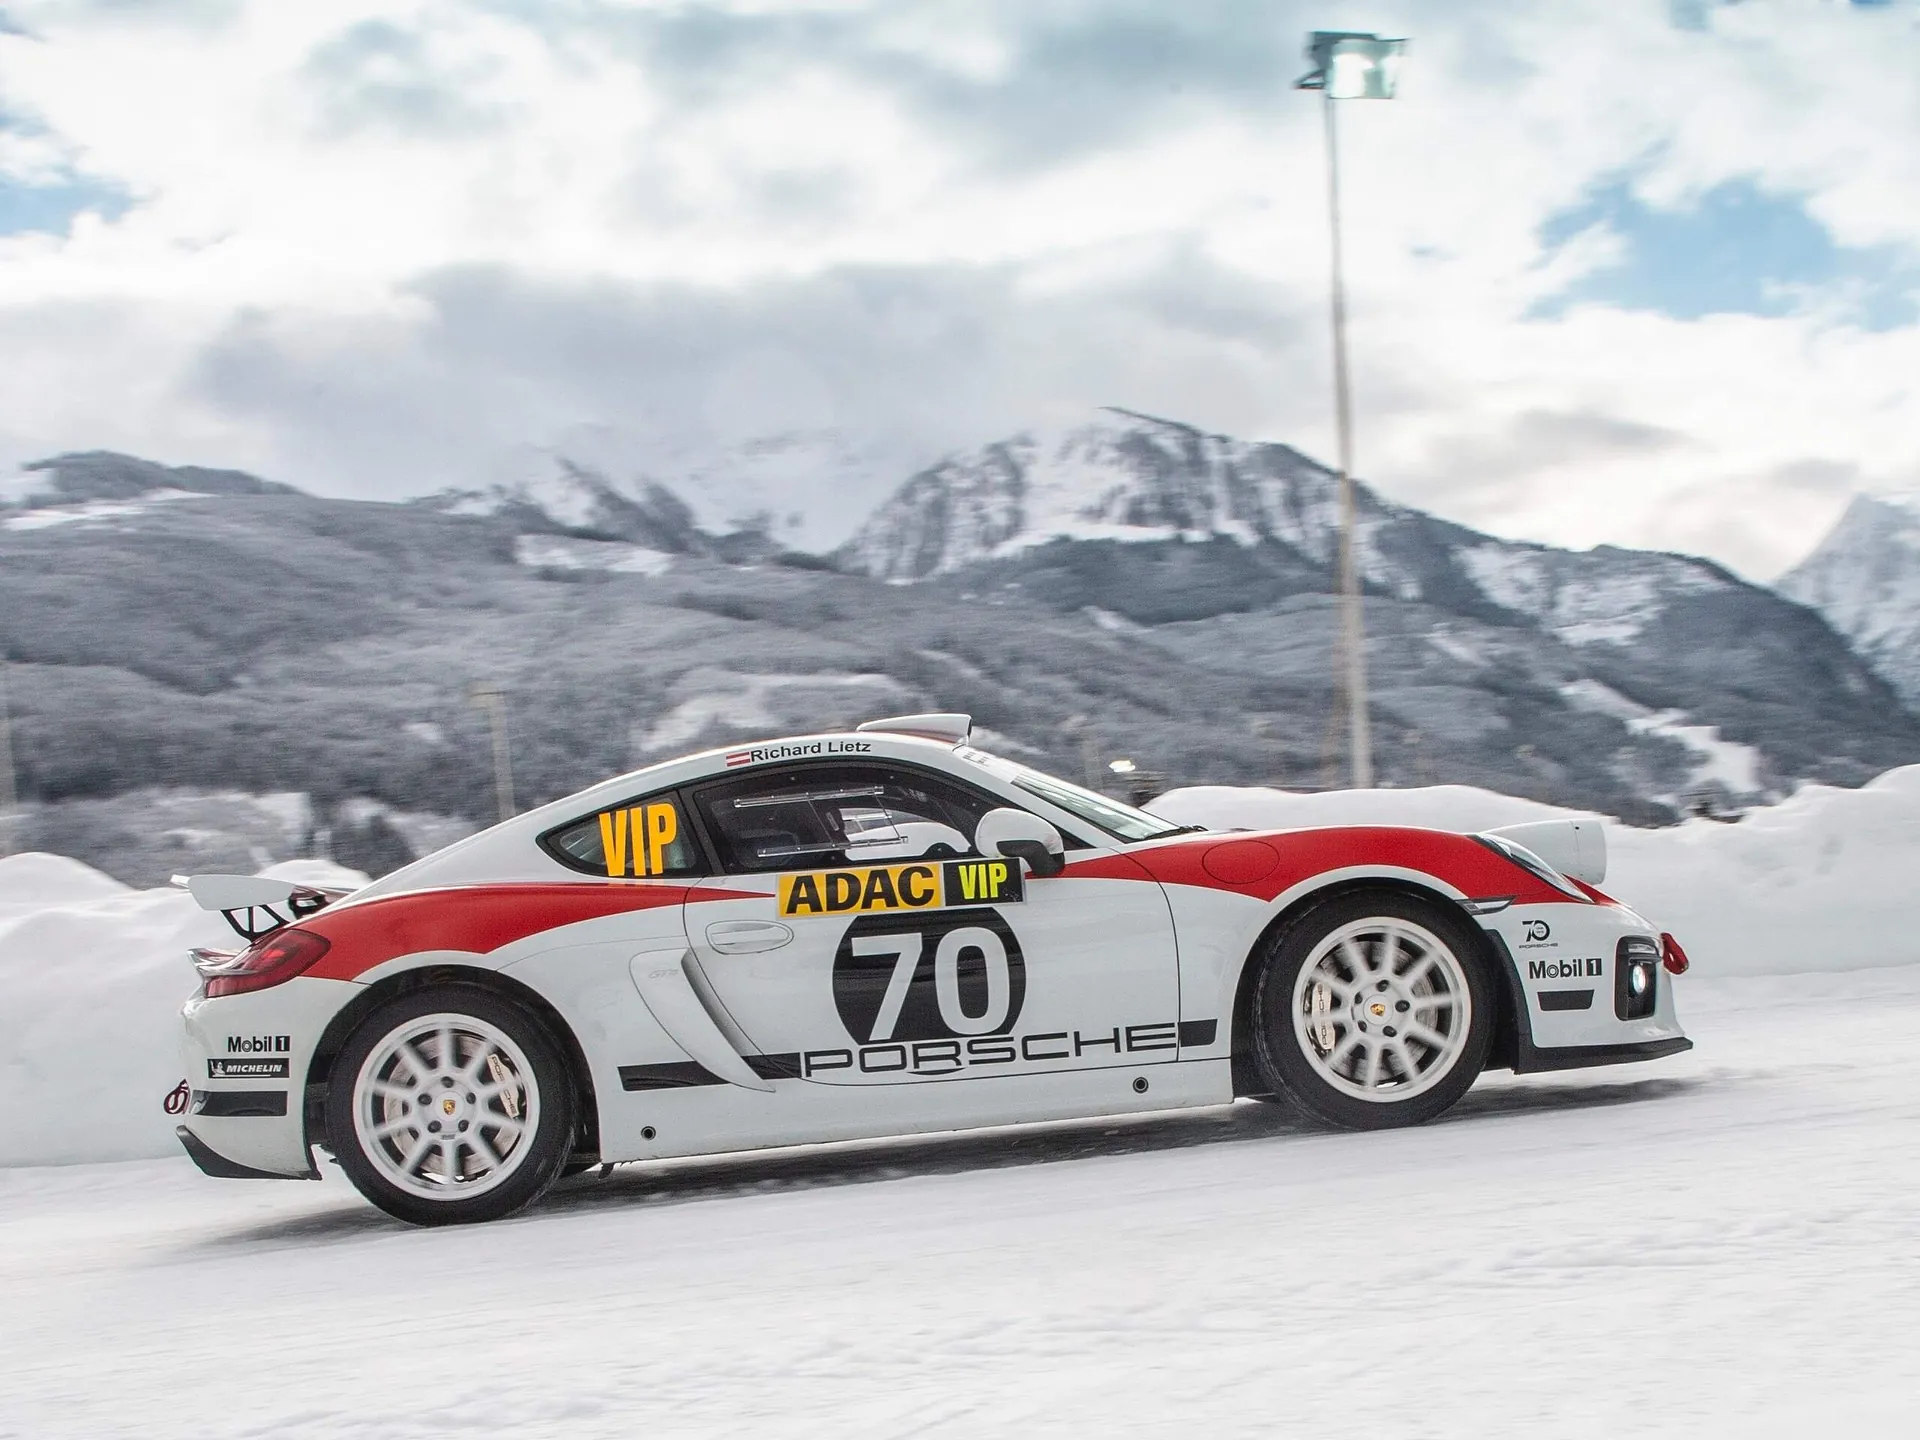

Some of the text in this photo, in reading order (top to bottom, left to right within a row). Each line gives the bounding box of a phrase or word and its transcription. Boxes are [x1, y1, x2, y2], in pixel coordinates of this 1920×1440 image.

[750, 740, 871, 762] Richard Lietz
[599, 802, 678, 877] VIP
[786, 866, 935, 915] ADAC
[957, 862, 1008, 900] VIP
[1522, 920, 1550, 942] 70
[851, 926, 1011, 1042] 70
[1529, 959, 1582, 979] Mobil
[228, 1036, 272, 1052] Mobil
[804, 1022, 1177, 1077] PORSCHE
[226, 1064, 282, 1073] MICHELIN
